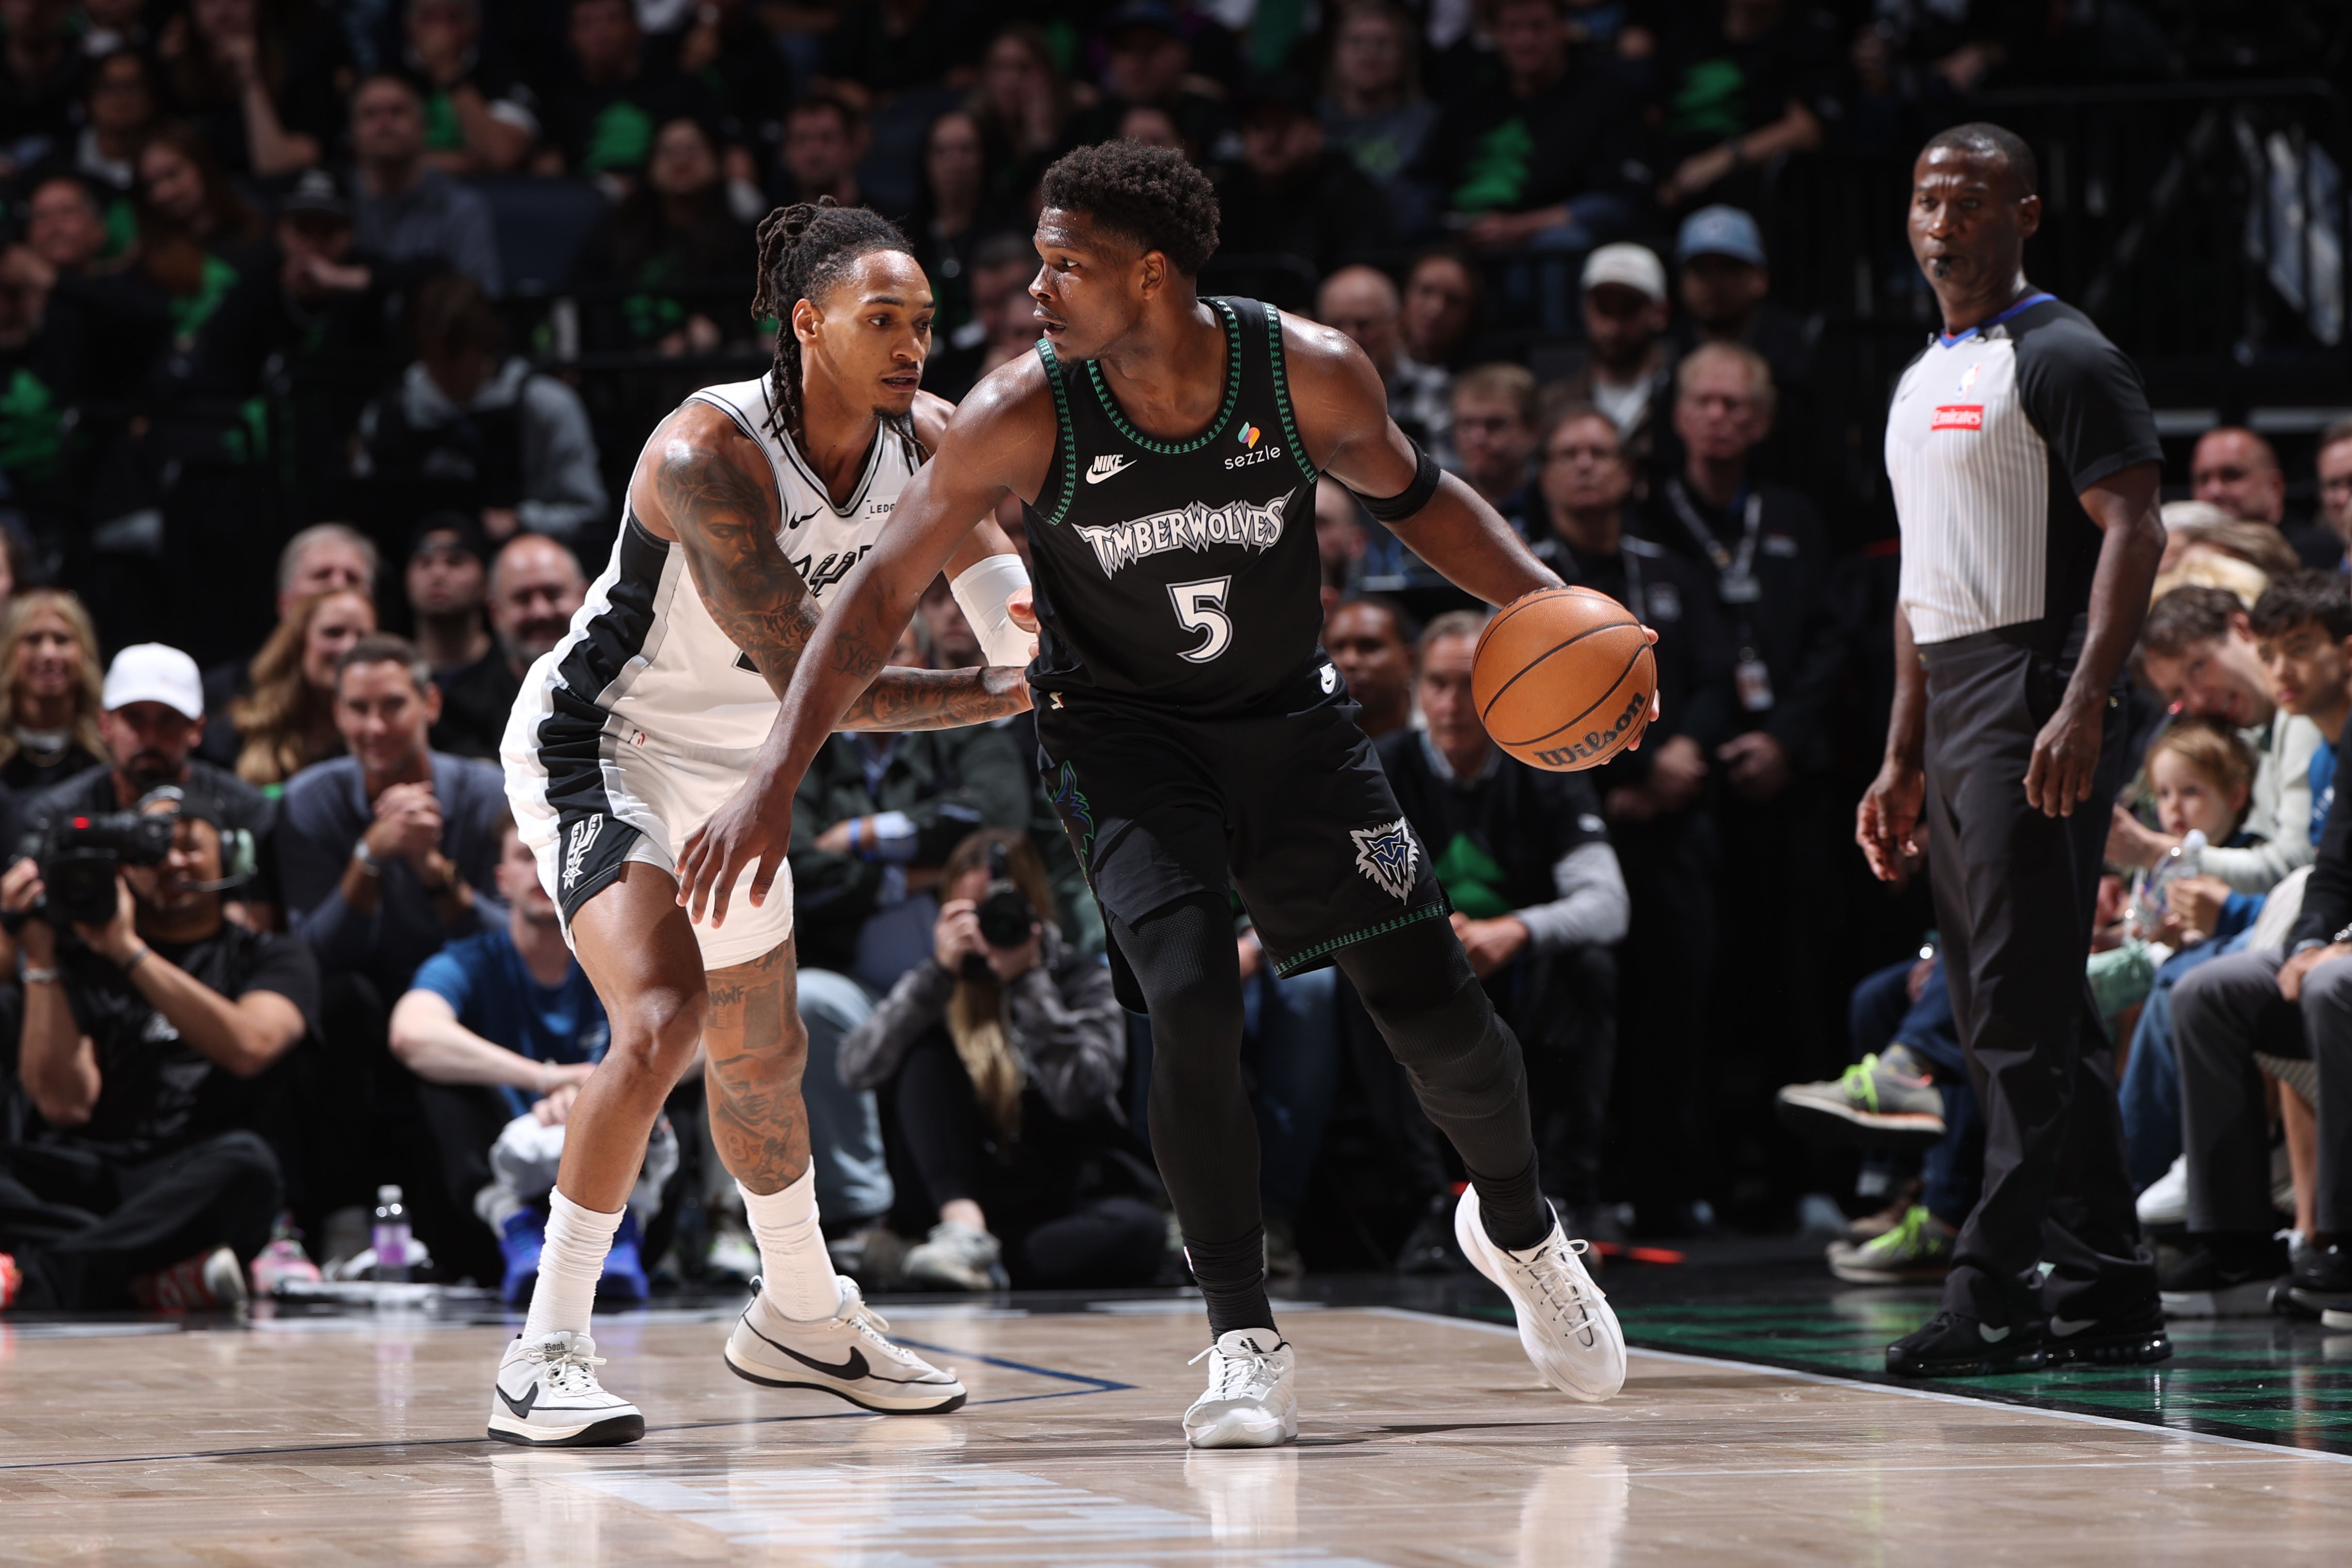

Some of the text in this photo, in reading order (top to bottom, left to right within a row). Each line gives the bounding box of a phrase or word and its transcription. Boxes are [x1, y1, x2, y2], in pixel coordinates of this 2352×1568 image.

[1093, 454, 1124, 472] NIKE
[1224, 445, 1280, 470] sezzle
[1072, 486, 1296, 580] TIMBERWOLVES
[1165, 575, 1232, 664] 5
[1532, 692, 1646, 766] Wilson
[544, 1341, 567, 1352] Book
